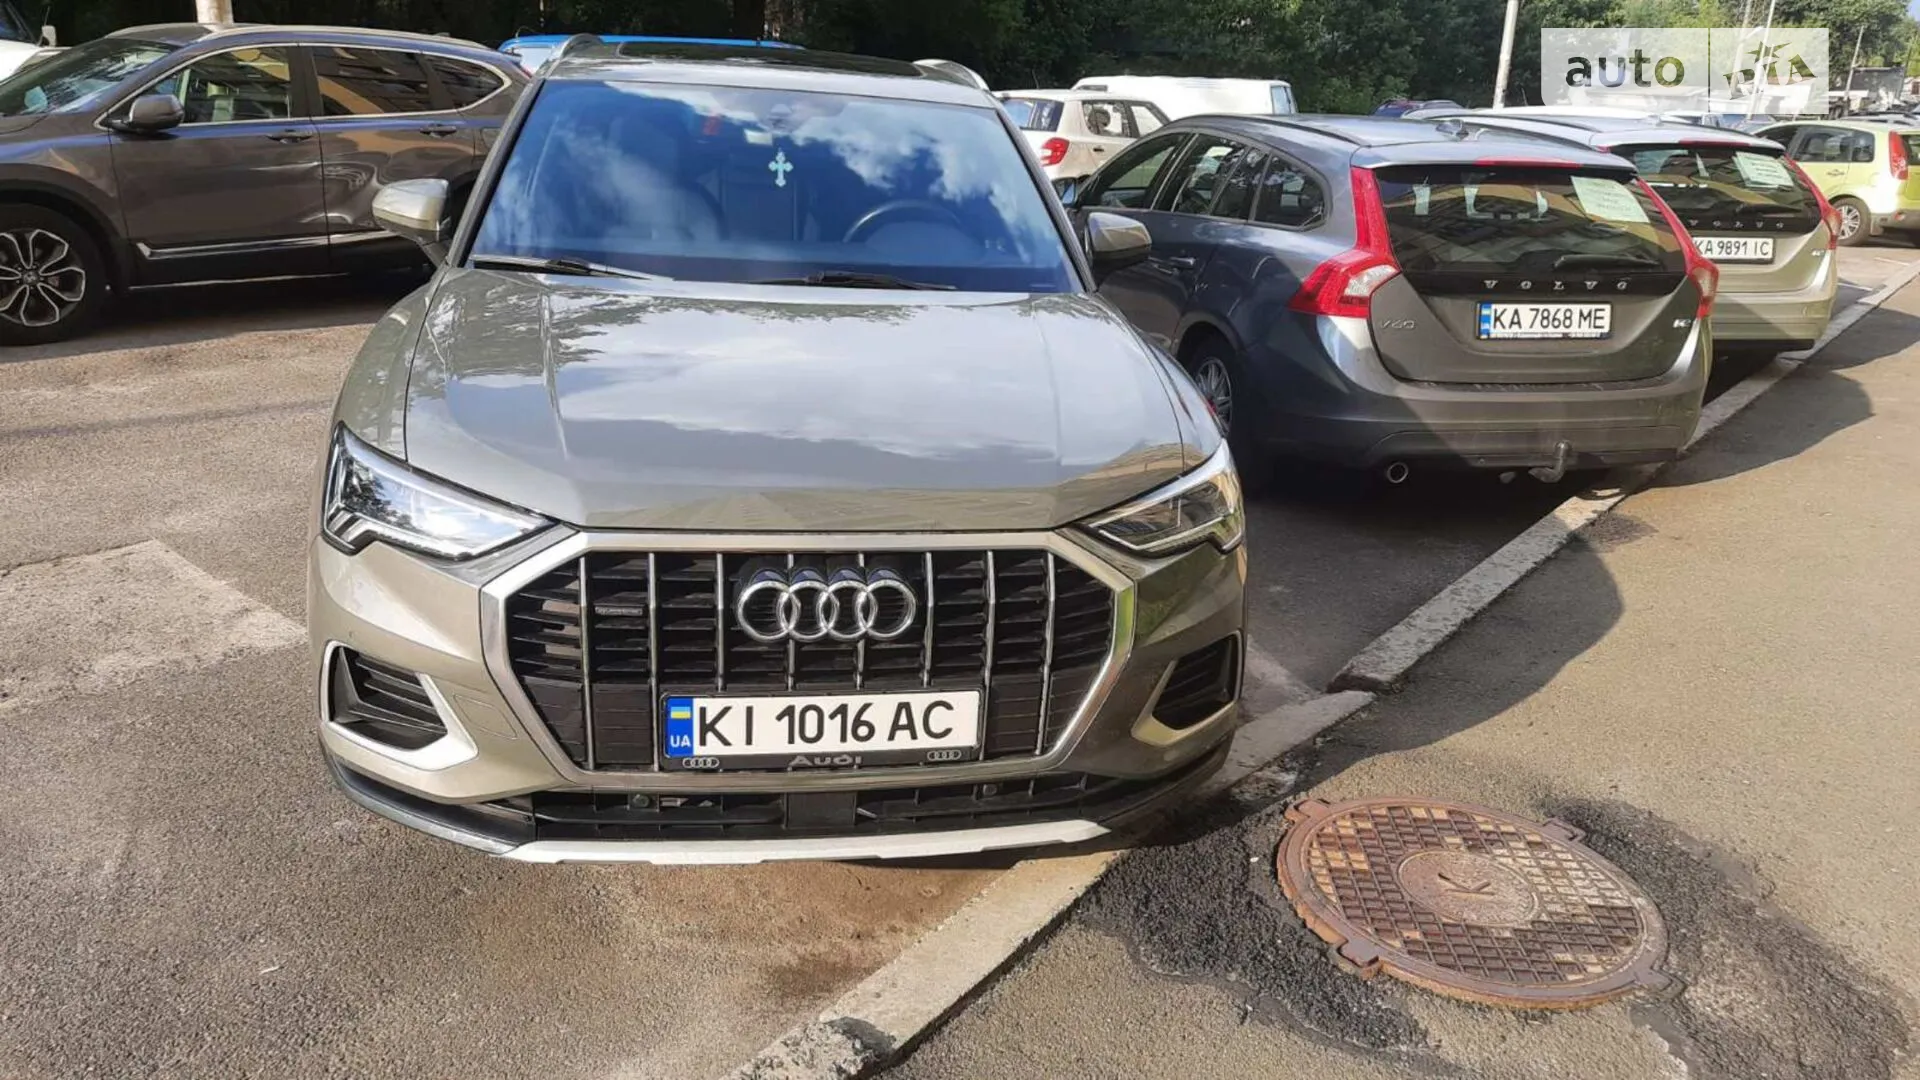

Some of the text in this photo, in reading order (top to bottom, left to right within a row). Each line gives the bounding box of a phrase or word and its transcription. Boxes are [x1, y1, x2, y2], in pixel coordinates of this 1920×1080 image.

[1717, 240, 1748, 256] 9891
[1754, 241, 1769, 256] IC
[1483, 278, 1628, 290] VOLVO
[1493, 308, 1605, 329] KA 7868 ME
[699, 700, 954, 747] KI 1016 AC
[670, 735, 691, 748] UA
